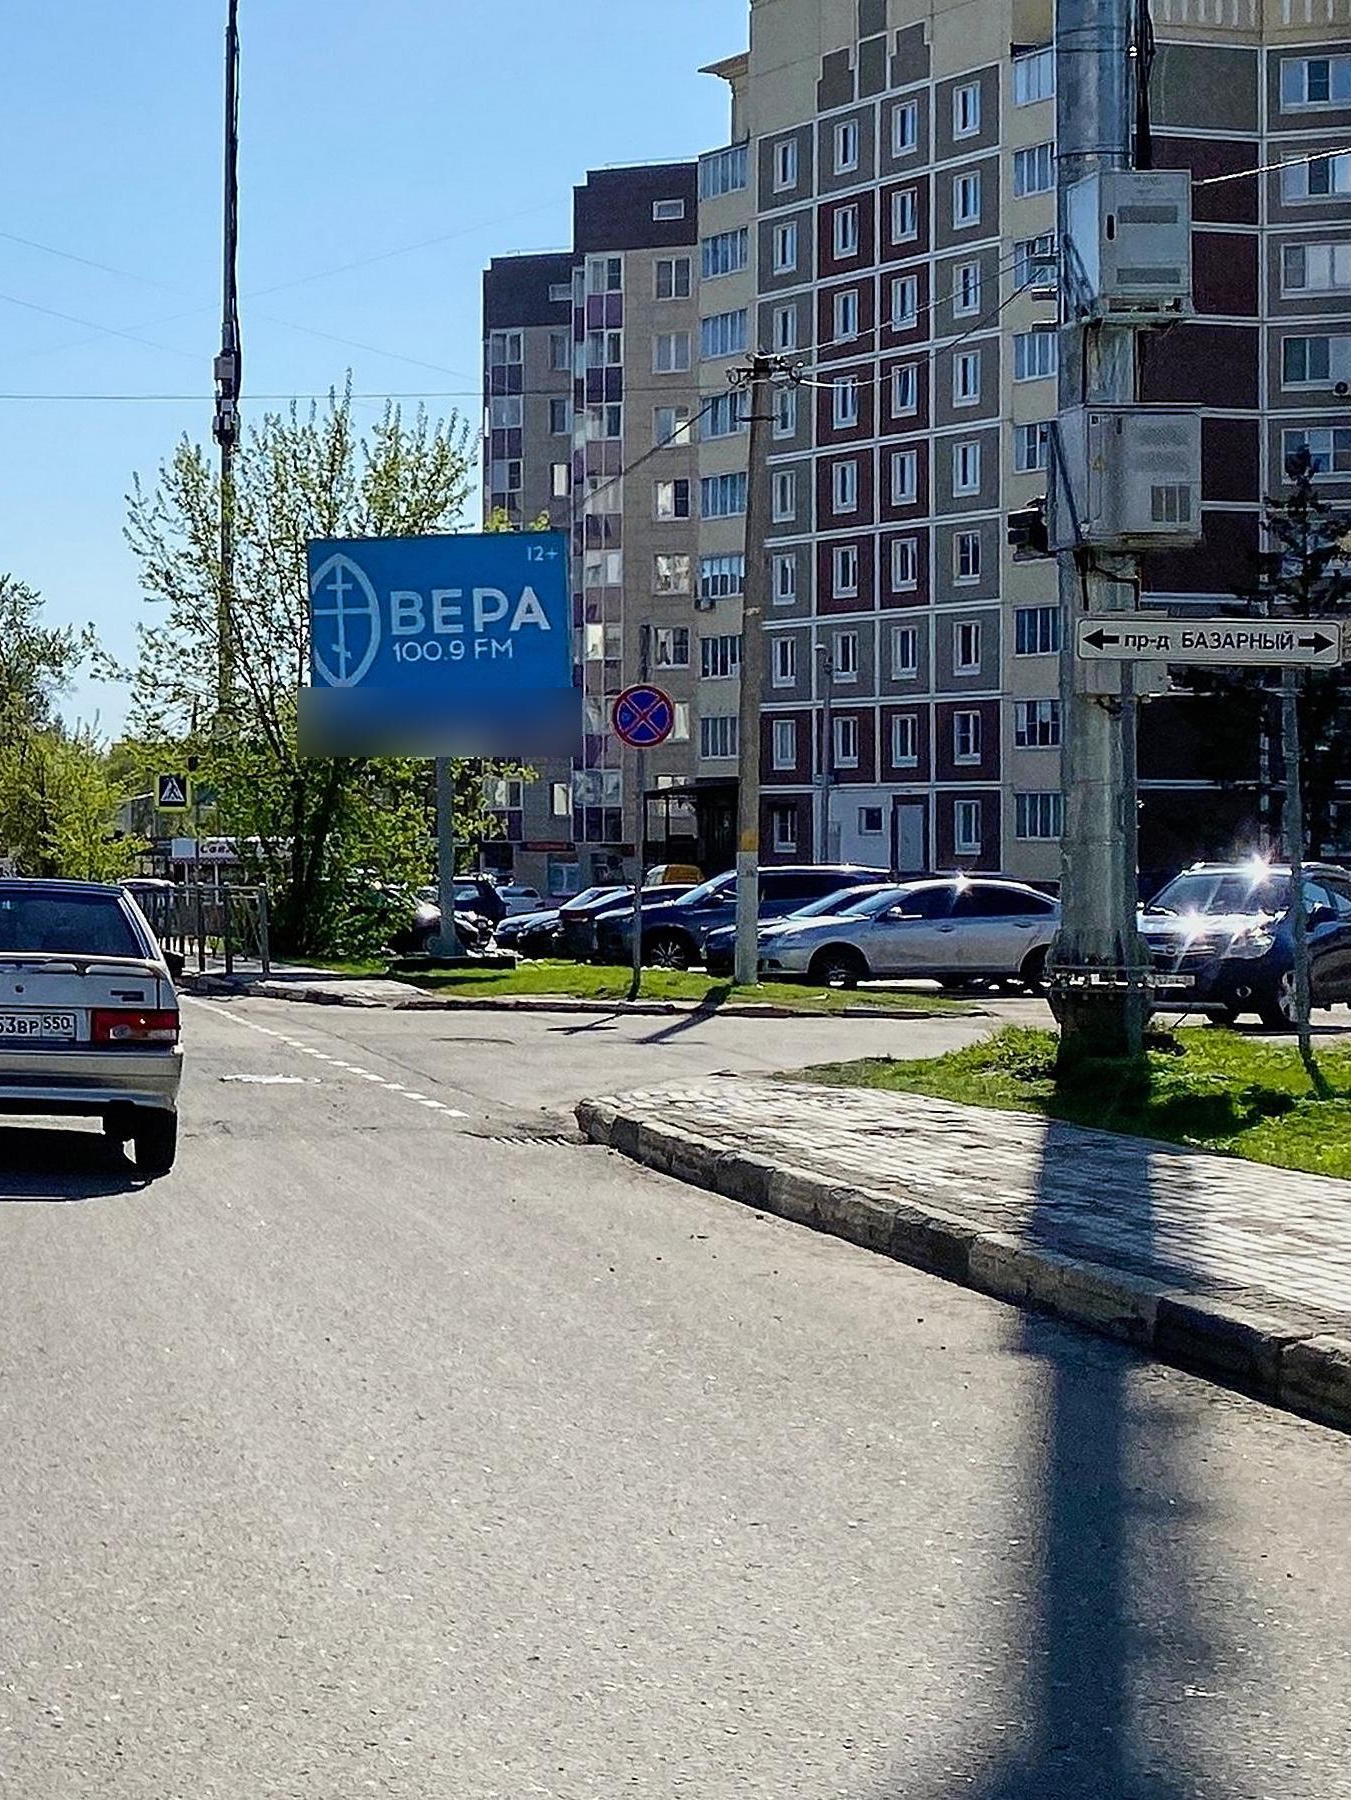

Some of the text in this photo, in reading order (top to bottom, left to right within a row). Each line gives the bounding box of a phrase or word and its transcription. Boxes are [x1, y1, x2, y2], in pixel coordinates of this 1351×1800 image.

[527, 545, 558, 562] 12+
[389, 585, 552, 636] ВЕРА
[392, 637, 514, 663] 100.9 FM
[1124, 630, 1295, 651] пр-д БАЗАРНЫЙ
[42, 1015, 71, 1031] 550
